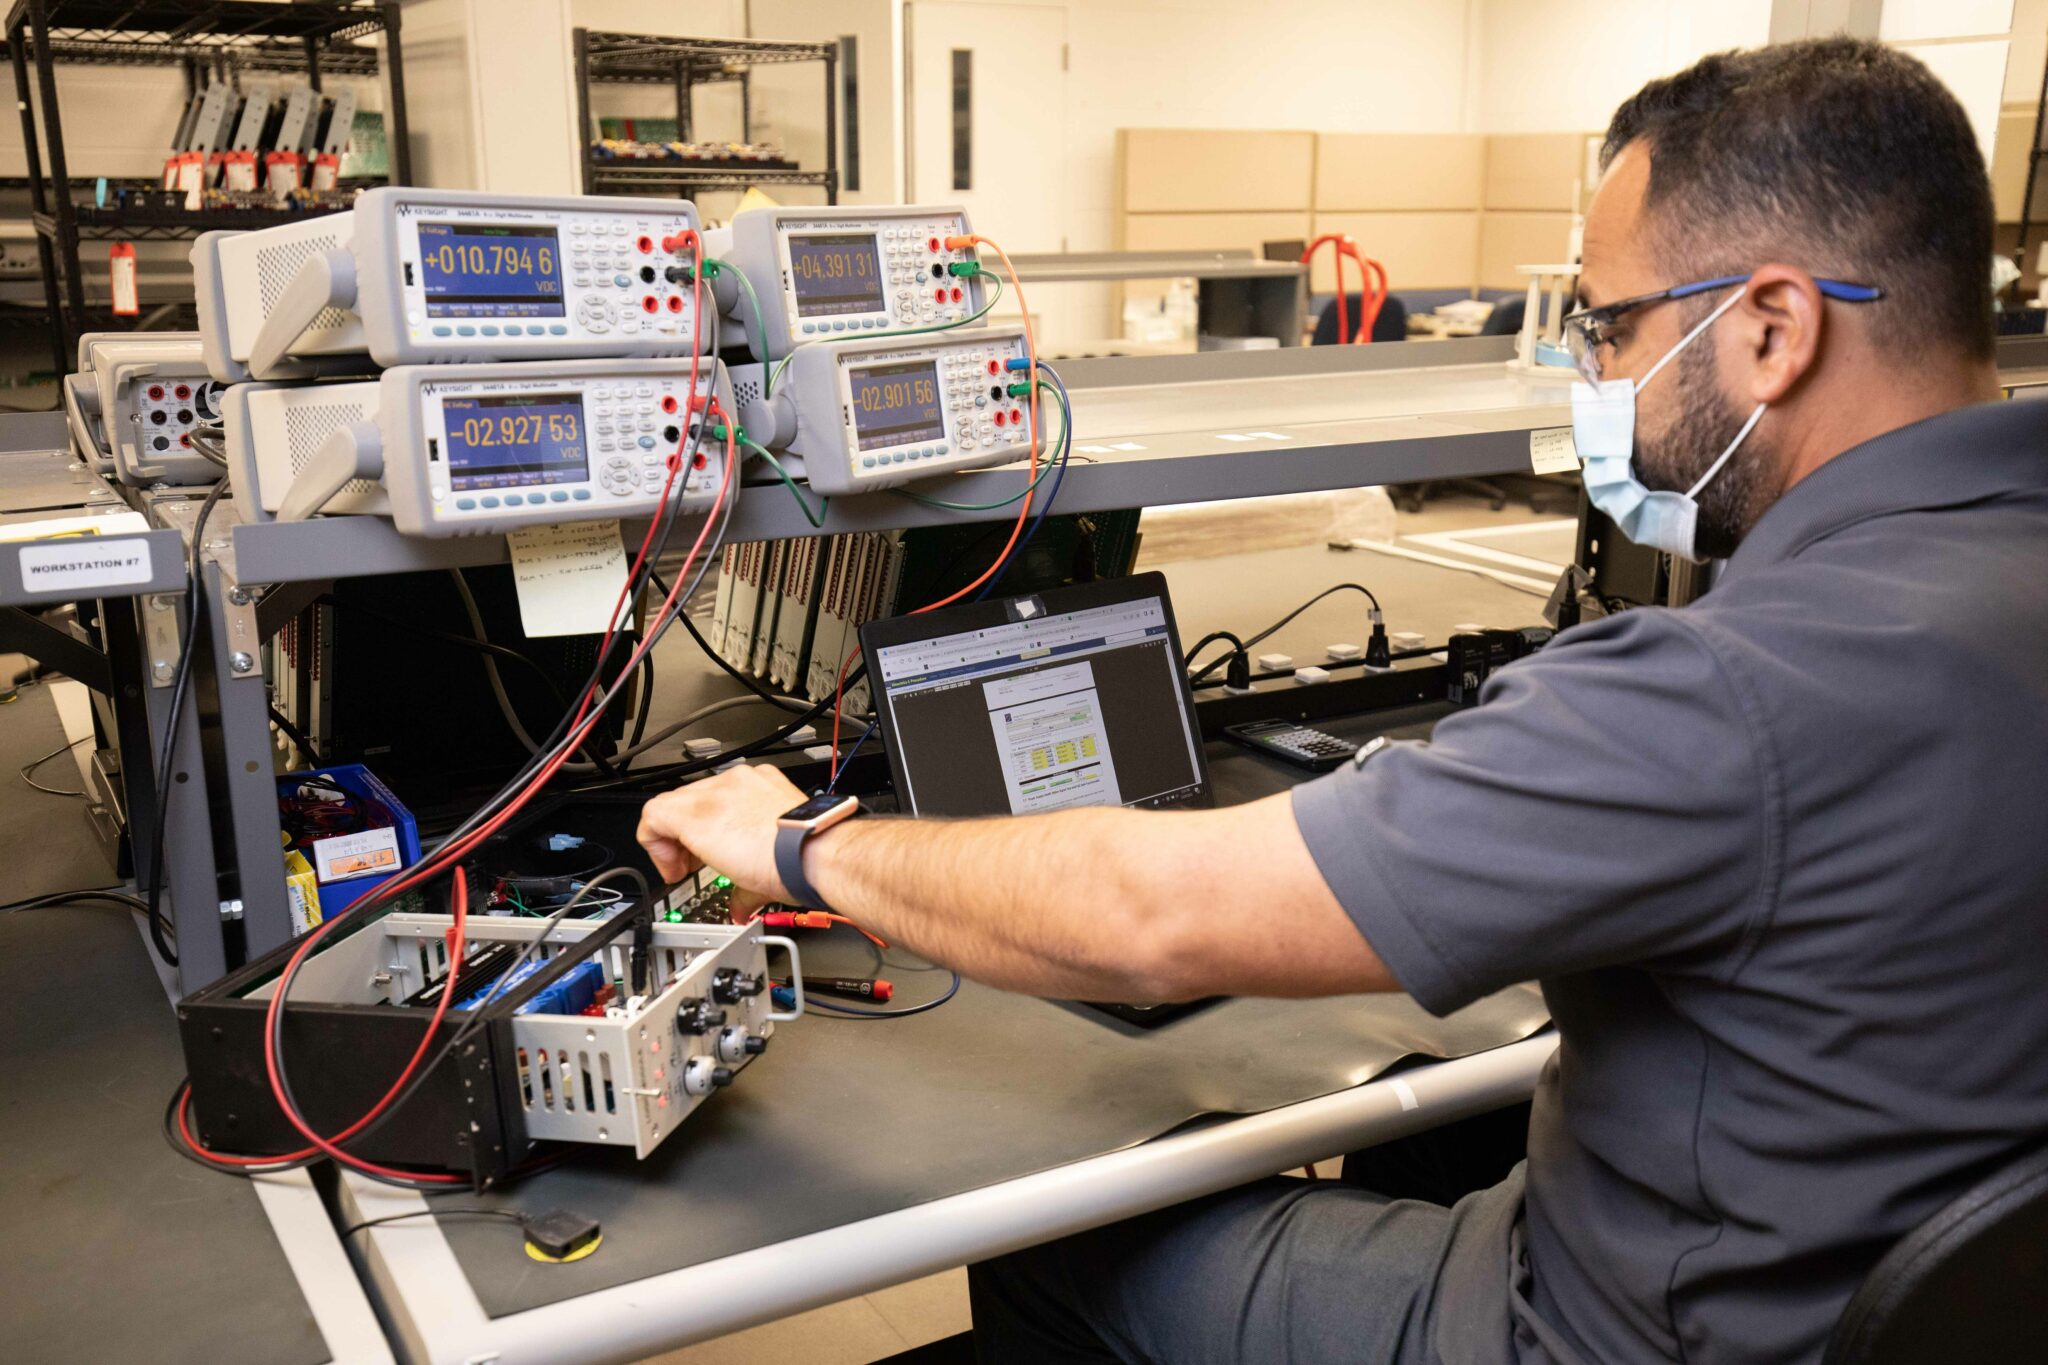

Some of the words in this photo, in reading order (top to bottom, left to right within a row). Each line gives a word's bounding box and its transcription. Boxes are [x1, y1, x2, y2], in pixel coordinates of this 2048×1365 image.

[414, 209, 448, 217] KEYSIGHT
[535, 280, 558, 292] VDC
[549, 414, 578, 442] 53
[560, 446, 582, 458] VDC
[30, 559, 122, 574] WORKSTATION
[126, 558, 140, 566] #7
